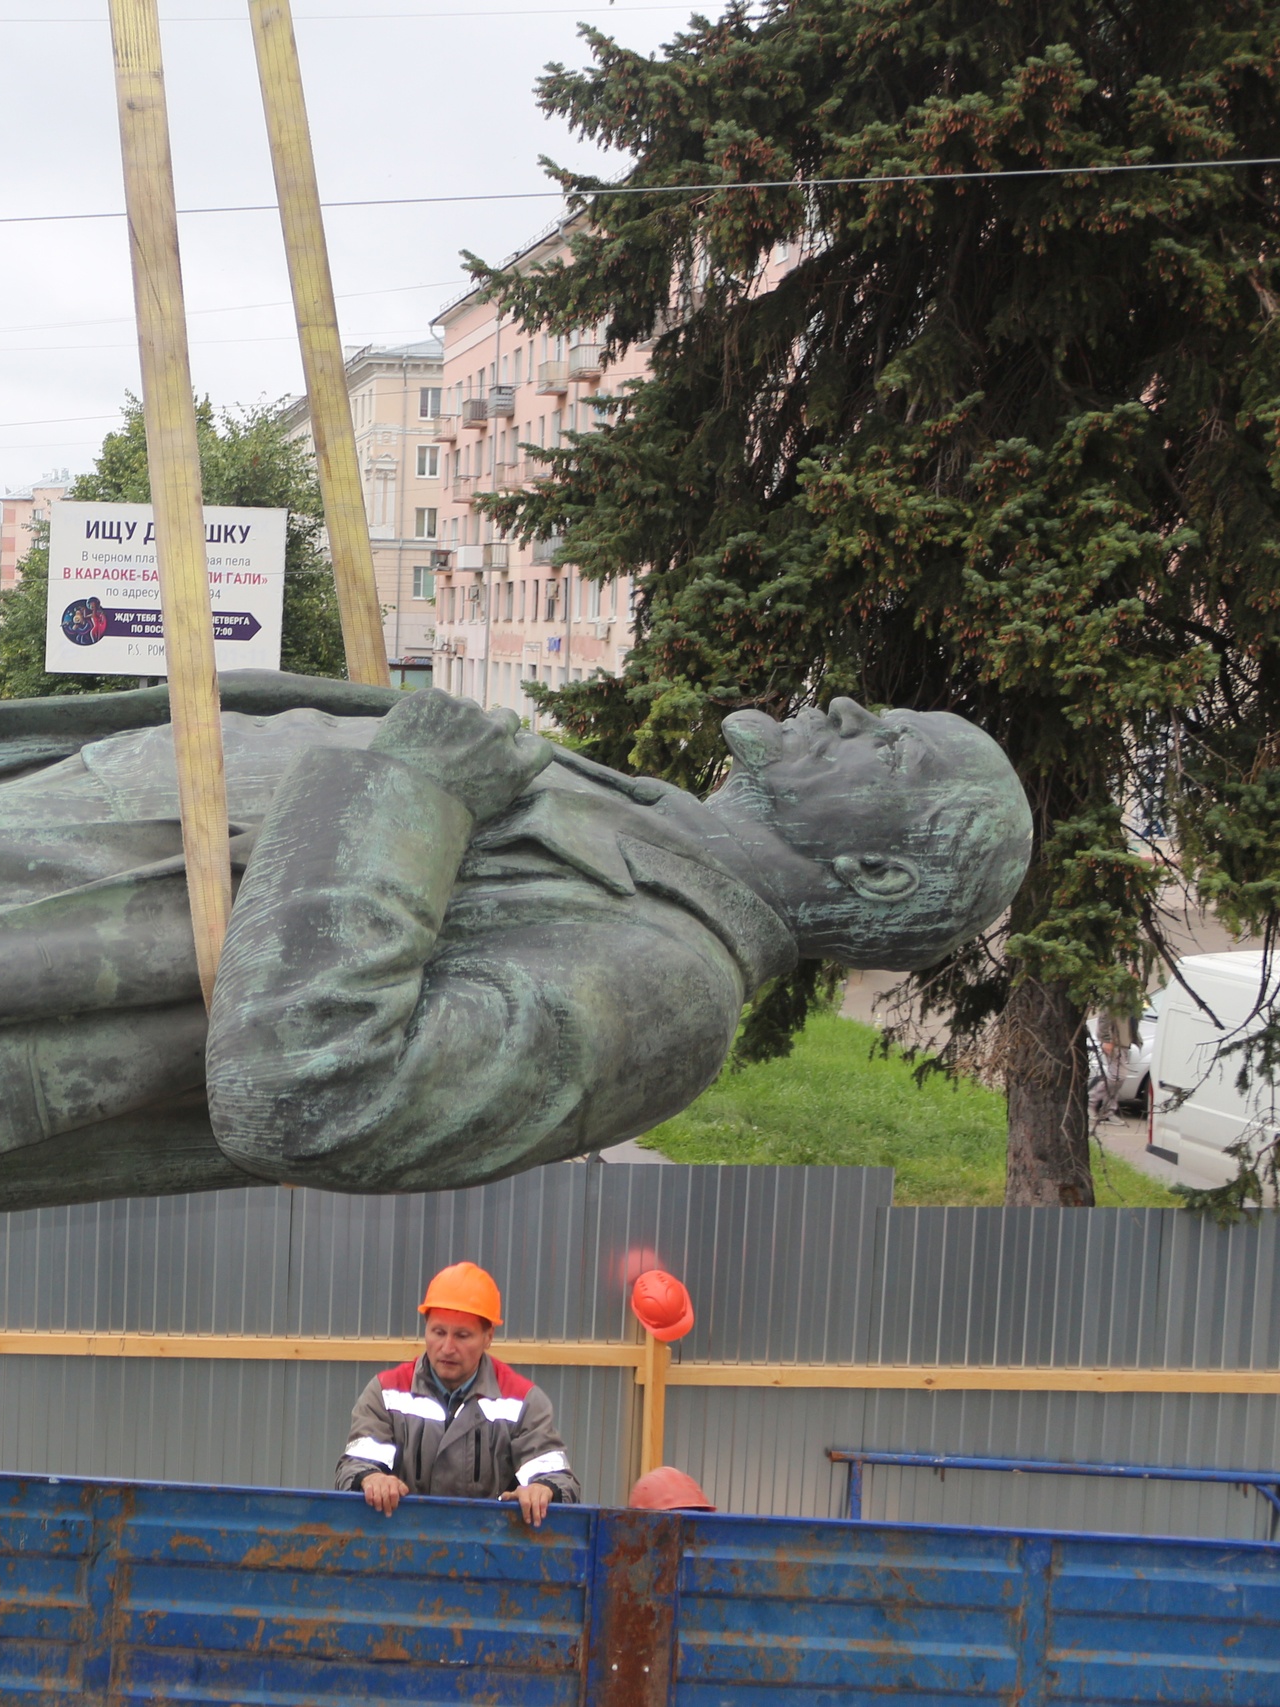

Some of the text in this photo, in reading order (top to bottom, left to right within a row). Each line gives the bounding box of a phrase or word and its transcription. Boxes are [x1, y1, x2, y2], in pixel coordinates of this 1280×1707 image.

[86, 520, 137, 544] ИЩУ
[81, 550, 89, 561] В
[92, 553, 132, 564] черном
[225, 557, 251, 566] пела
[63, 567, 71, 579] В
[75, 568, 159, 582] КАРАОКЕ-БА
[226, 572, 268, 585] ГАЛИ»
[105, 588, 119, 597] по
[114, 612, 135, 622] ЖДУ
[136, 613, 156, 622] ТЕБЯ
[131, 624, 142, 633] ПО
